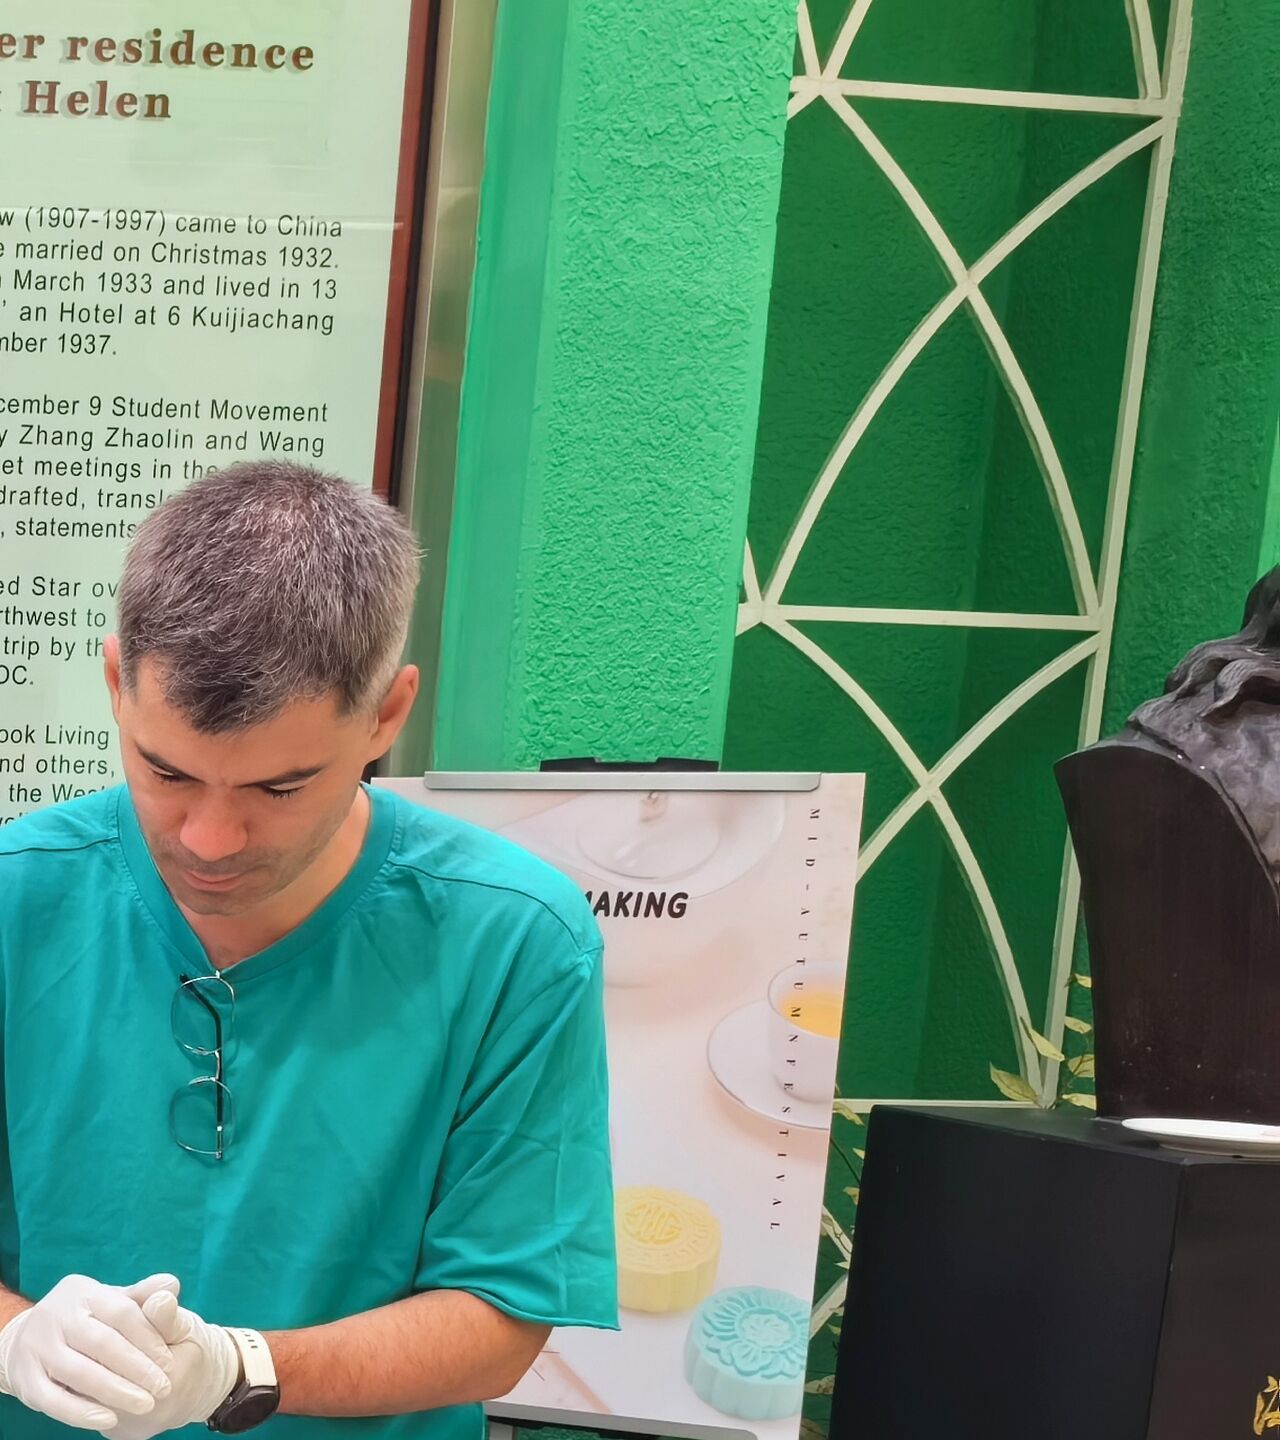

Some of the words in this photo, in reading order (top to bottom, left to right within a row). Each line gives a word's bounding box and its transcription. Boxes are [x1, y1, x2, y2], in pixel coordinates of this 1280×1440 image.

[65, 27, 314, 71] residence
[22, 79, 172, 119] Helen
[24, 205, 166, 238] (1907-1997)
[175, 216, 237, 234] came
[246, 213, 268, 236] to
[277, 213, 342, 238] China
[15, 238, 104, 262] married
[112, 245, 141, 263] on
[150, 241, 268, 267] Christmas
[278, 245, 339, 269] 1932.
[13, 268, 85, 293] March
[97, 271, 153, 295] 1933
[162, 274, 206, 296] and
[215, 275, 271, 298] lived
[280, 276, 300, 299] in
[312, 278, 337, 300] 13
[59, 301, 124, 325] Hotel
[133, 305, 157, 326] at
[167, 304, 181, 327] 6
[192, 305, 334, 337] Kuijiachang
[57, 332, 117, 356] 1937.
[89, 394, 102, 417] 9
[111, 395, 201, 420] Student
[209, 398, 328, 423] Movement
[44, 723, 110, 751] Living
[35, 753, 115, 779] others,
